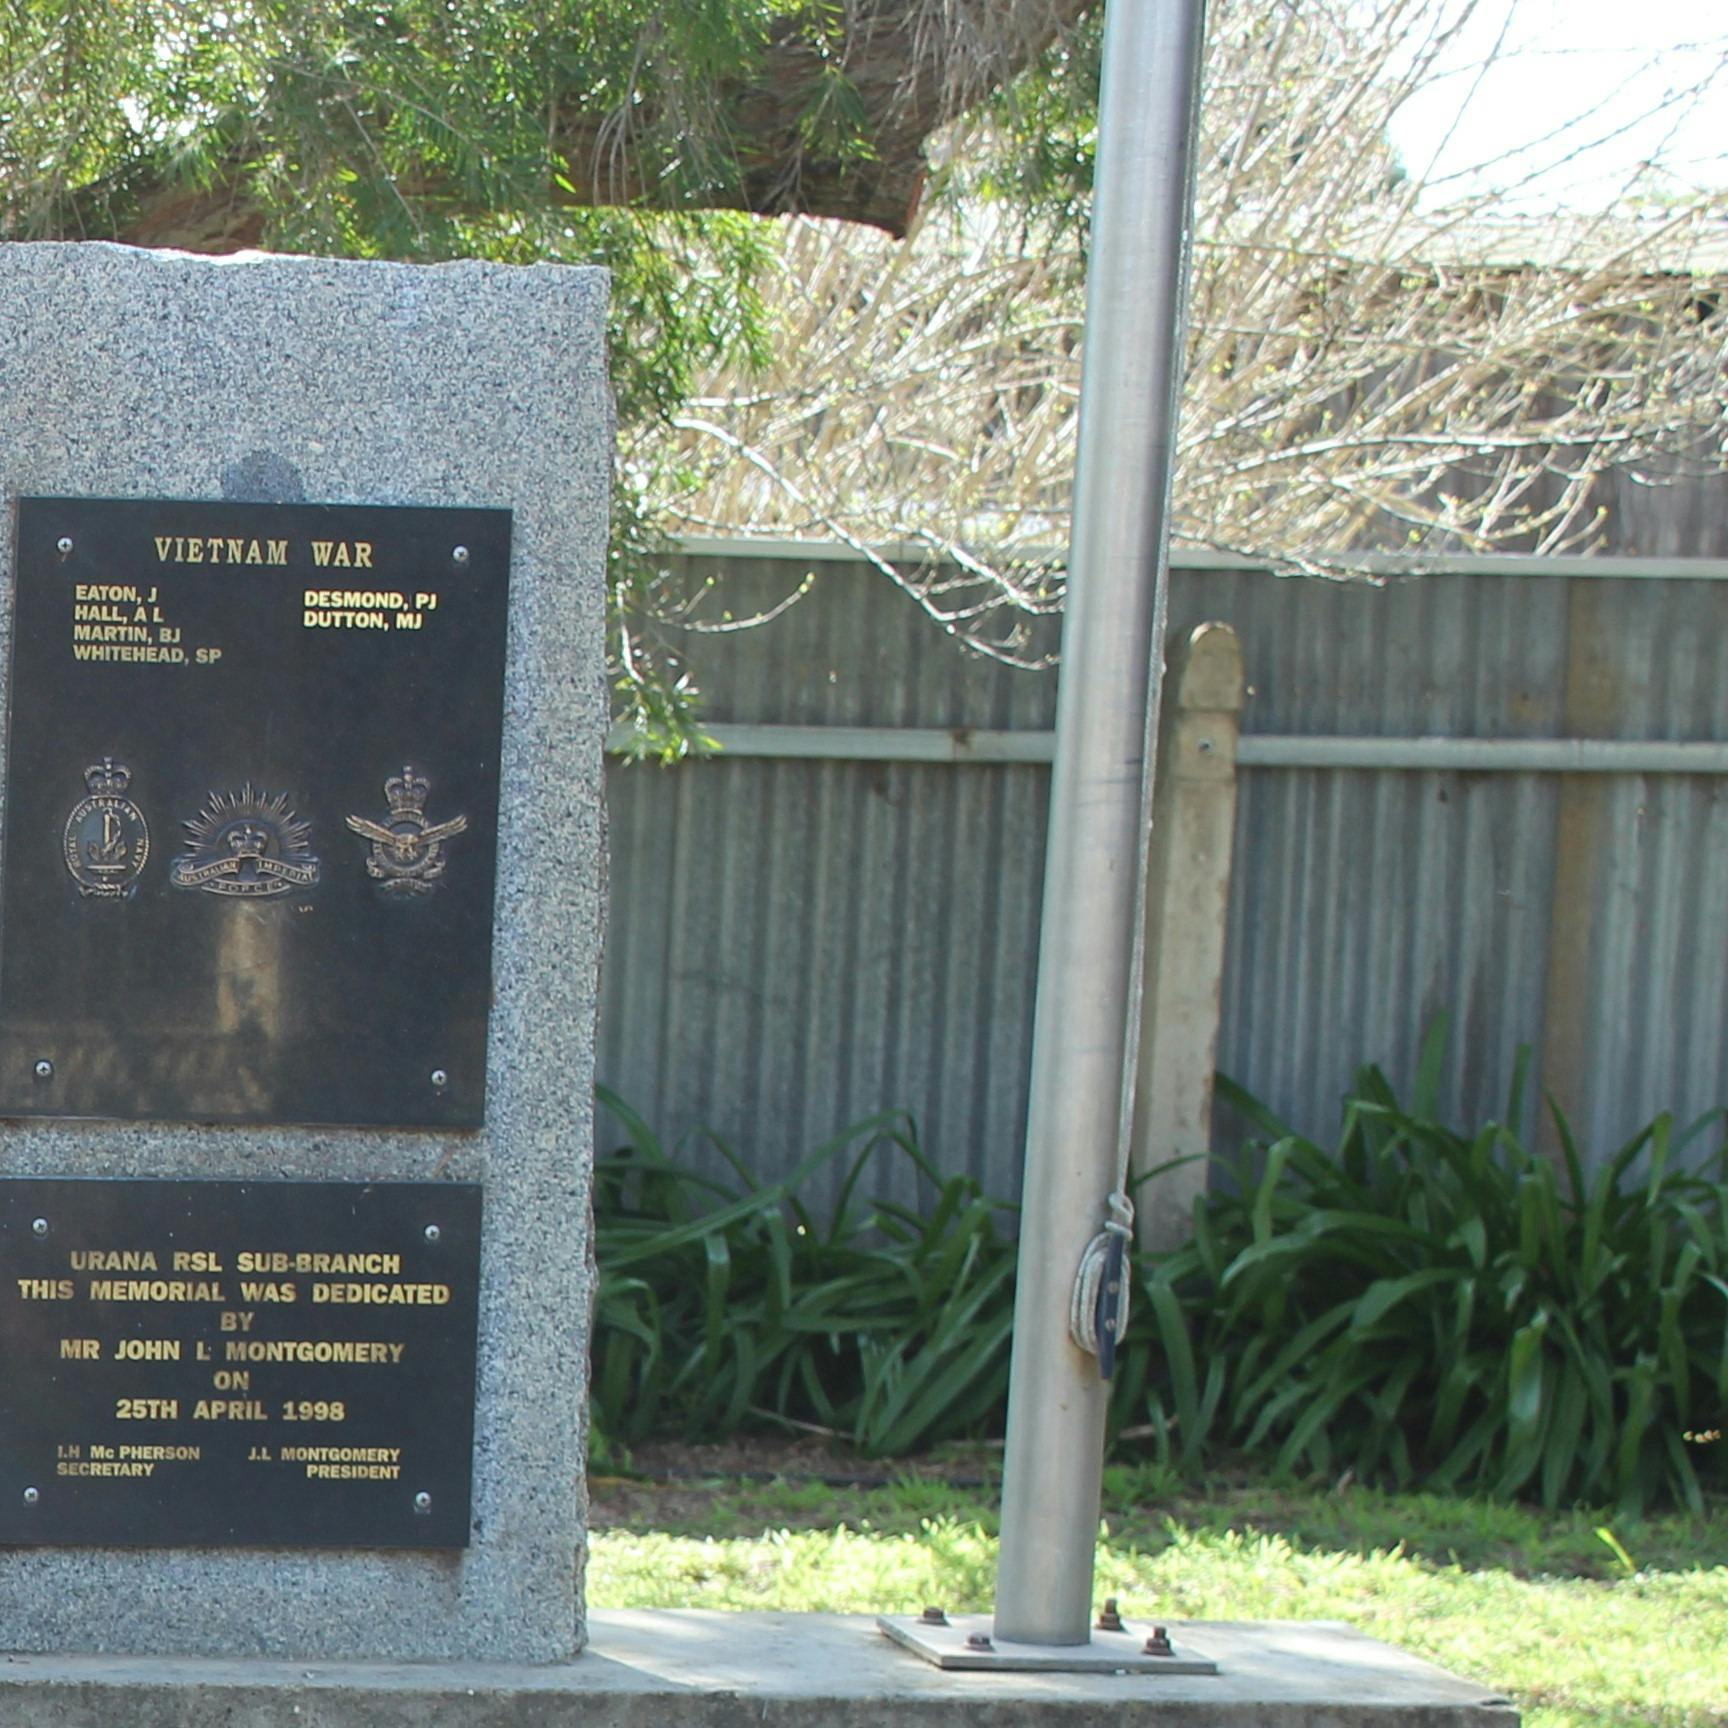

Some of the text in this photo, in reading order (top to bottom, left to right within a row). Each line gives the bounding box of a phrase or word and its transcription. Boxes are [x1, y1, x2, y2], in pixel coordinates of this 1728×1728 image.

[155, 537, 372, 567] VIETNAM WAR
[76, 585, 157, 604] EATON, J
[304, 591, 436, 612] DESMOND, PJ
[75, 605, 163, 624] HALL, A L
[304, 611, 422, 631] DUTTON, MJ
[74, 625, 180, 644] MARTIN, BJ
[73, 645, 221, 665] WHITEHEAD, SP
[71, 1252, 400, 1274] URANA RSL SUB-BRANCH
[18, 1280, 449, 1304] THIS MEMORIAL WAS DEDICATED
[221, 1312, 253, 1331] BY
[61, 1340, 402, 1362] MR JOHN L MONTGOMERY
[214, 1371, 249, 1389] ON
[116, 1399, 344, 1420] 25TH APRIL 1998
[58, 1445, 199, 1459] I.H Mc PHERSON
[248, 1447, 400, 1462] J.L MONTGOMERY
[58, 1462, 154, 1476] SECRETARY
[307, 1465, 400, 1479] PRESIDENT
